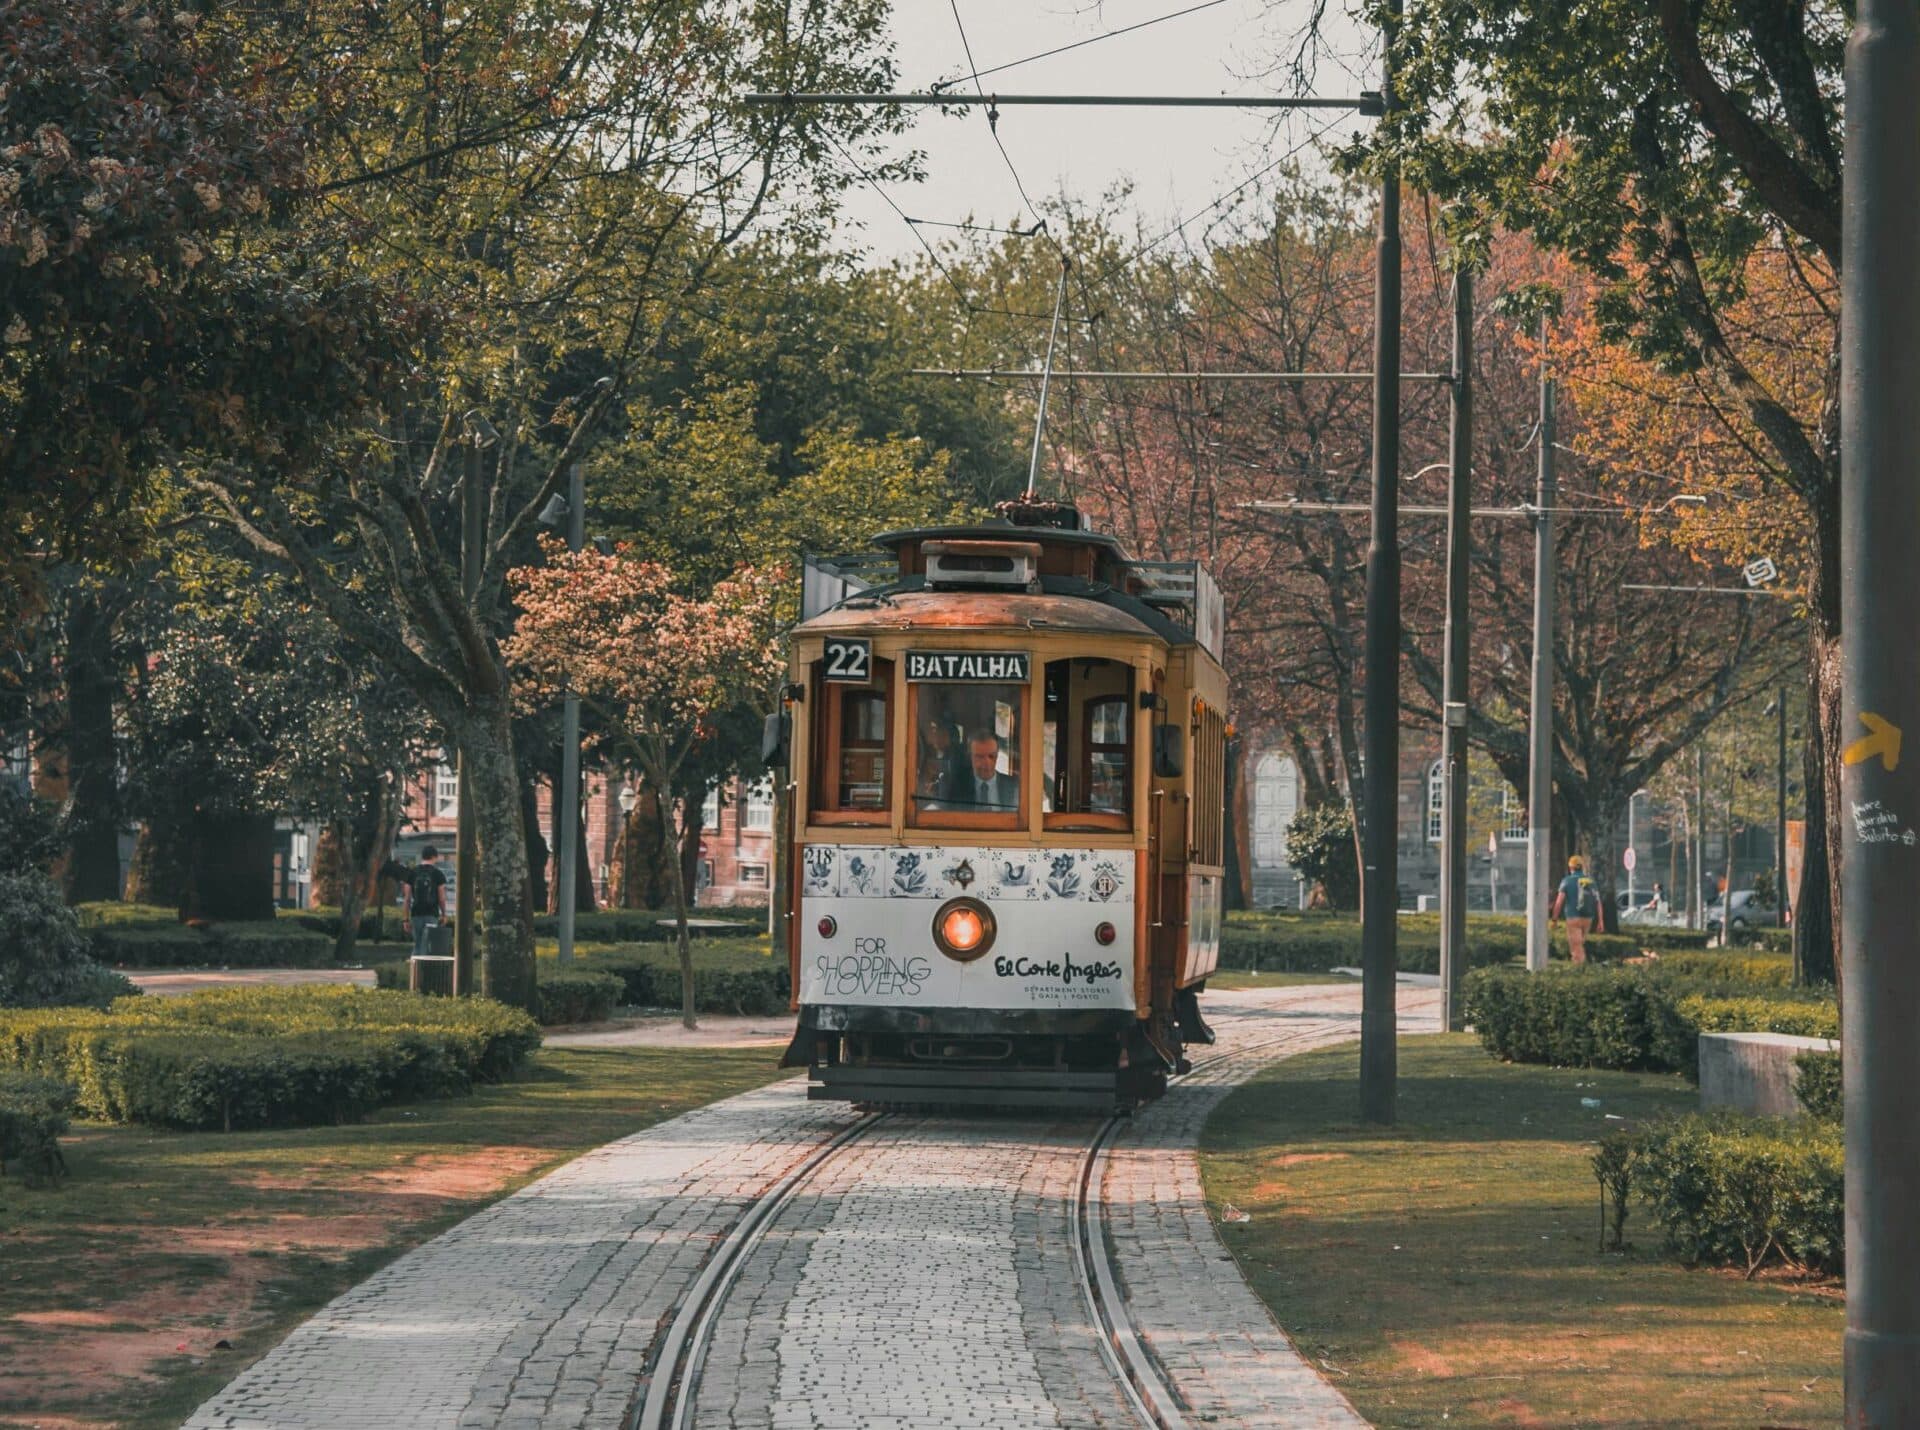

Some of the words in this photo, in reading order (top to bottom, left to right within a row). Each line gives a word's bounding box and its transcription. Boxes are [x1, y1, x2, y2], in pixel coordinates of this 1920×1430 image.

[827, 644, 866, 676] 22
[911, 655, 1023, 678] BATALHA
[804, 847, 832, 864] 218
[855, 937, 886, 954] FOR
[816, 955, 932, 981] SHOPPING
[994, 955, 1013, 977] El
[1015, 957, 1060, 977] Corte
[1063, 952, 1122, 984] Inglés
[824, 972, 921, 996] LOVERS
